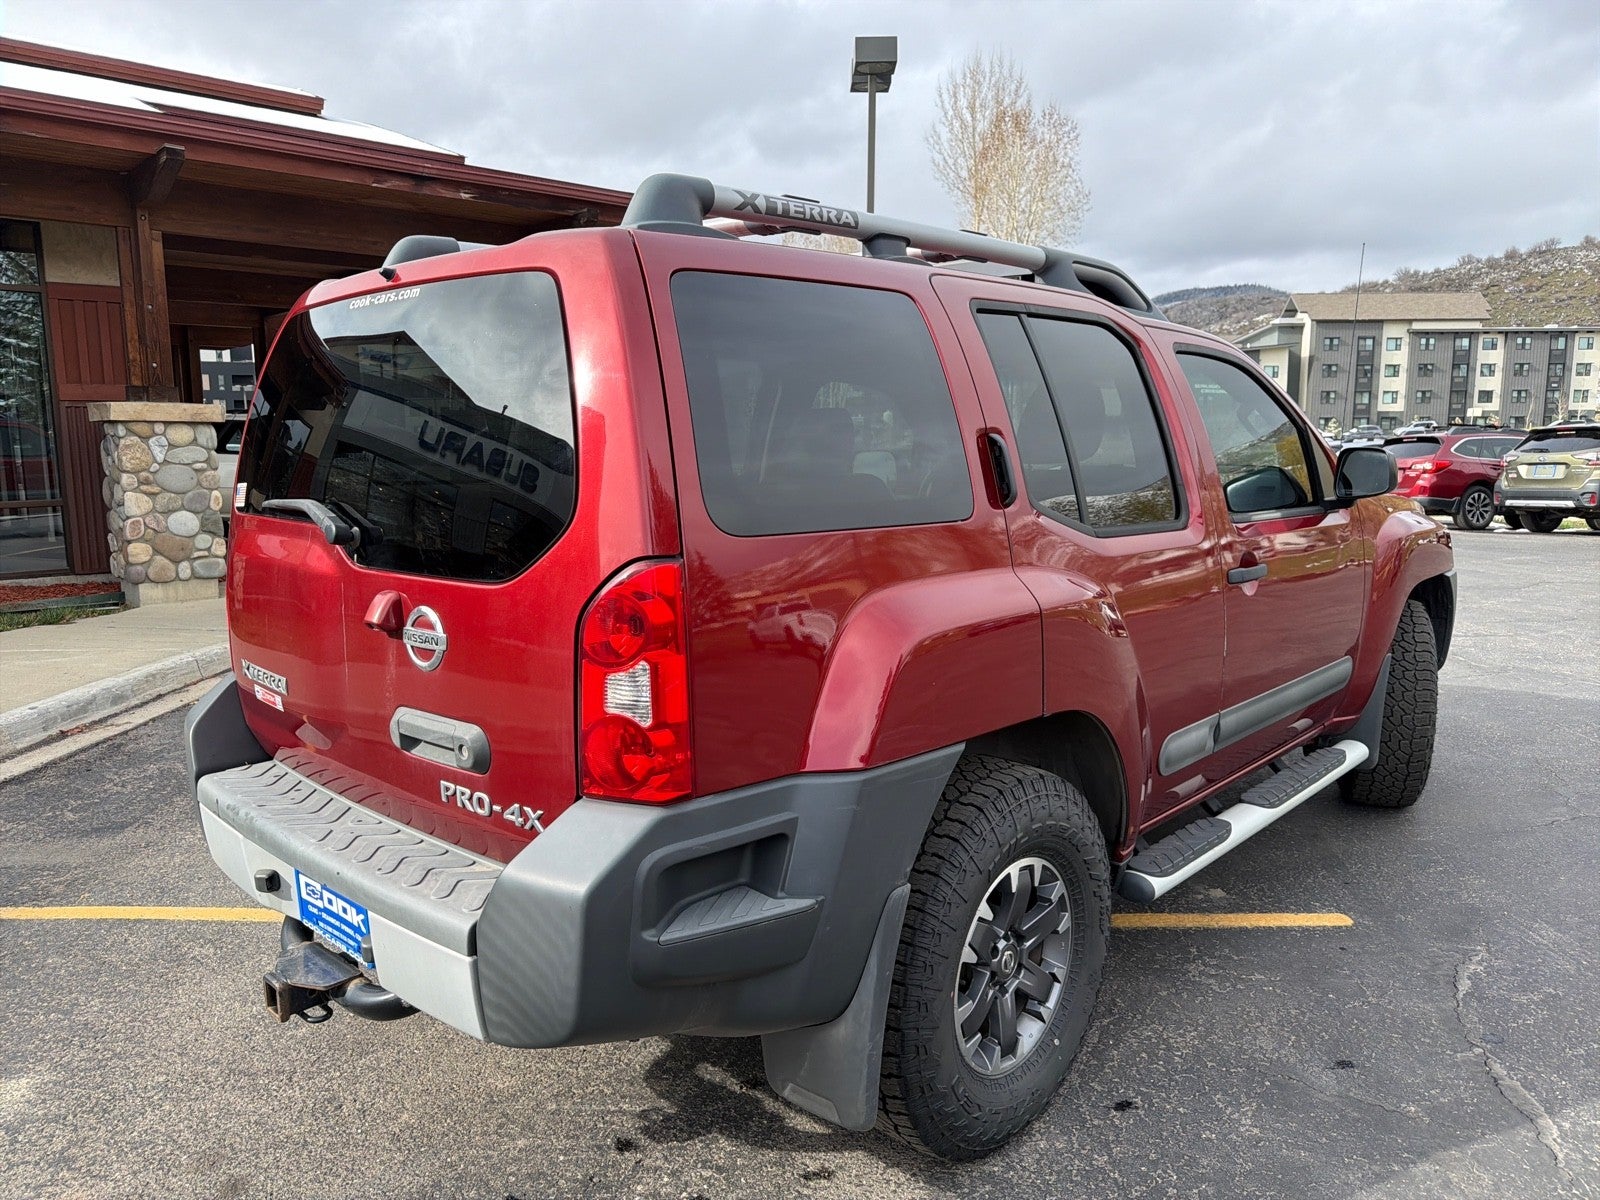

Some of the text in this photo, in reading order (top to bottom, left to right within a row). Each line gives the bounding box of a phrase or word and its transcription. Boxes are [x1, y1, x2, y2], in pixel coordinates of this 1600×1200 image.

[732, 189, 860, 229] XTERRA
[349, 288, 421, 310] cook-cars.com
[404, 631, 439, 646] NISSAN
[241, 658, 288, 696] XTERRA
[440, 780, 545, 833] PRO-4X
[299, 873, 368, 934] COOK
